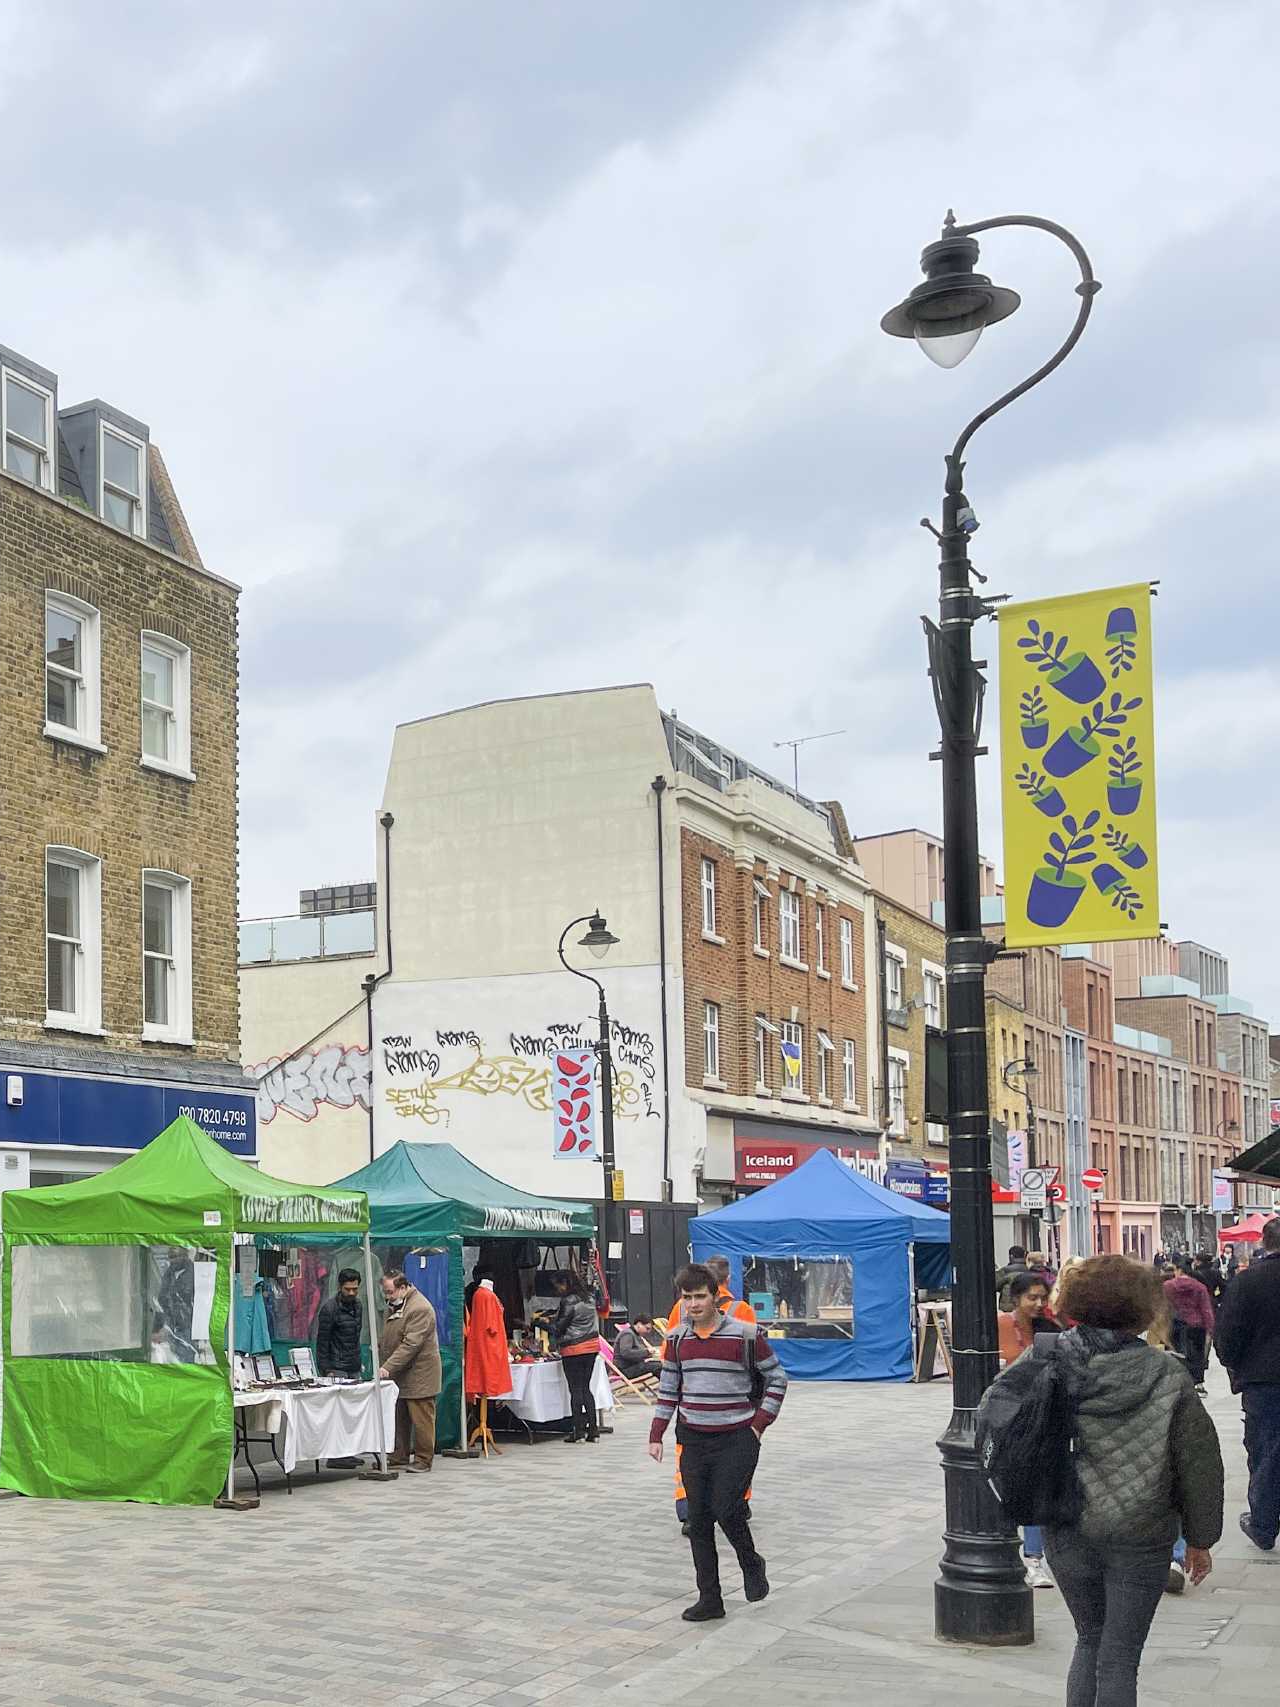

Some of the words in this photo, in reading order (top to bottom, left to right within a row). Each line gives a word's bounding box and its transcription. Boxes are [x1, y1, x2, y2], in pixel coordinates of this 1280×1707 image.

[197, 1107, 221, 1124] 7820
[222, 1110, 247, 1126] 4798
[745, 1154, 794, 1167] Iceland
[241, 1195, 279, 1223] LOWER
[280, 1195, 320, 1223] MARSH
